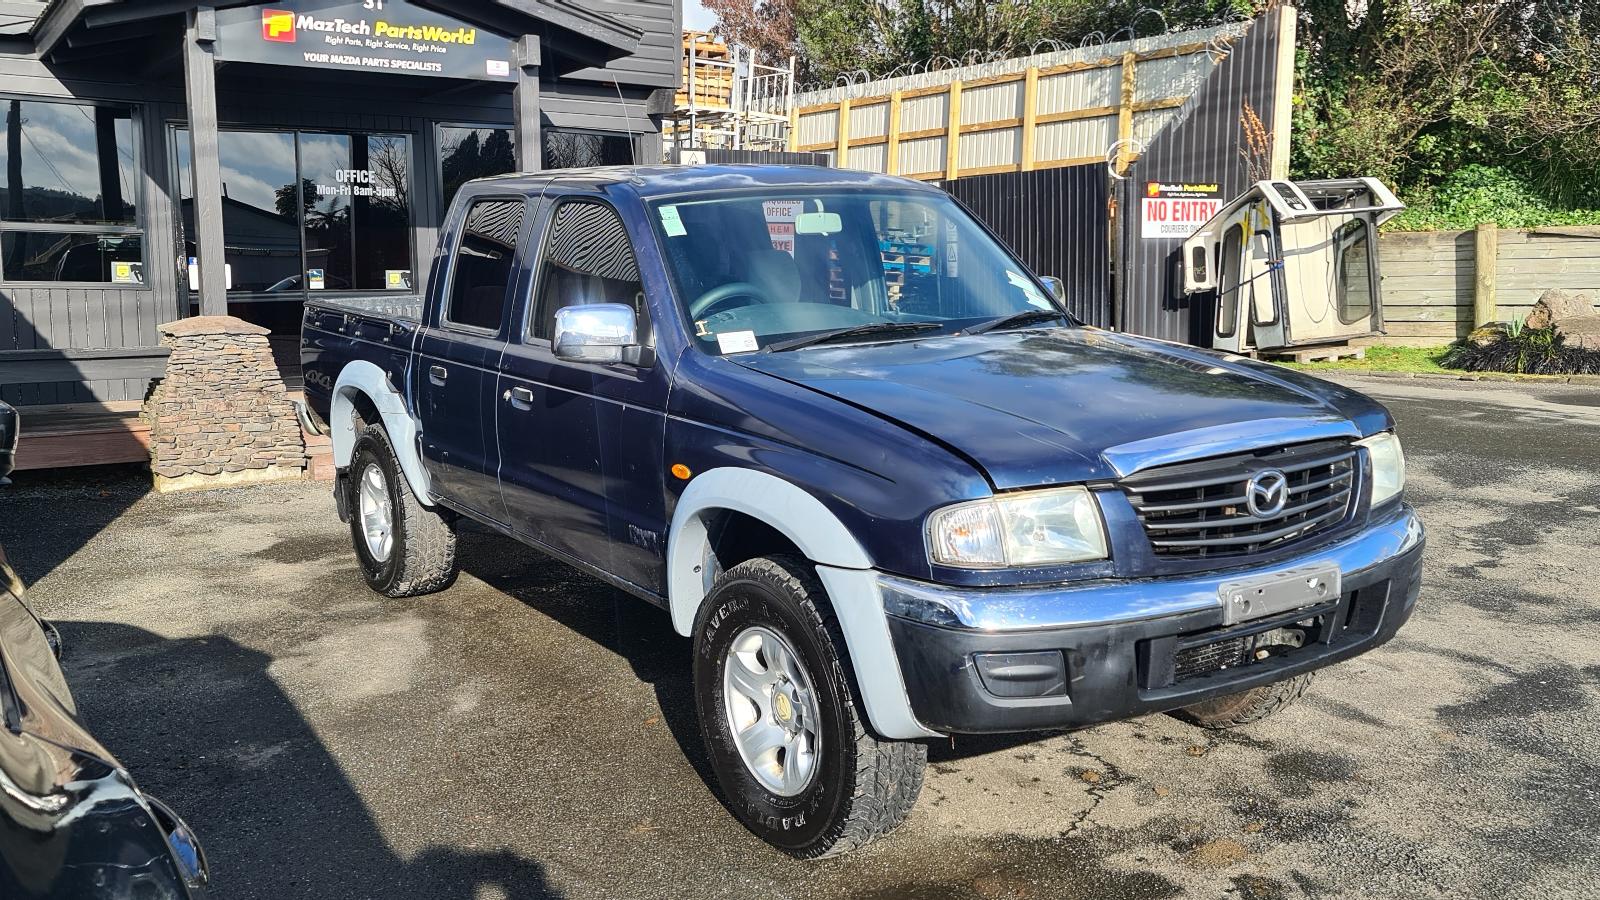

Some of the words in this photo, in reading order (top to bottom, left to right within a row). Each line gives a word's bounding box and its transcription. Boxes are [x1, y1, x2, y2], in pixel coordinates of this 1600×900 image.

[296, 15, 371, 35] MazTech
[375, 21, 476, 45] PartsWorld
[325, 35, 343, 46] Right
[344, 37, 363, 47] Parts,
[365, 38, 383, 49] Right
[384, 41, 411, 51] Service,
[412, 43, 430, 53] Right
[430, 45, 447, 53] Price
[304, 52, 329, 63] YOUR
[330, 55, 361, 66] MAZDA
[362, 57, 390, 68] PARTS
[390, 60, 442, 72] SPECIALISTS
[335, 169, 376, 184] OFFICE
[316, 184, 352, 196] Mon-Fri
[353, 185, 396, 197] 8am-5pm
[766, 207, 792, 217] OFFICE
[1147, 201, 1167, 222] NO
[1172, 201, 1217, 222] ENTRY
[1160, 224, 1189, 234] COURIERS
